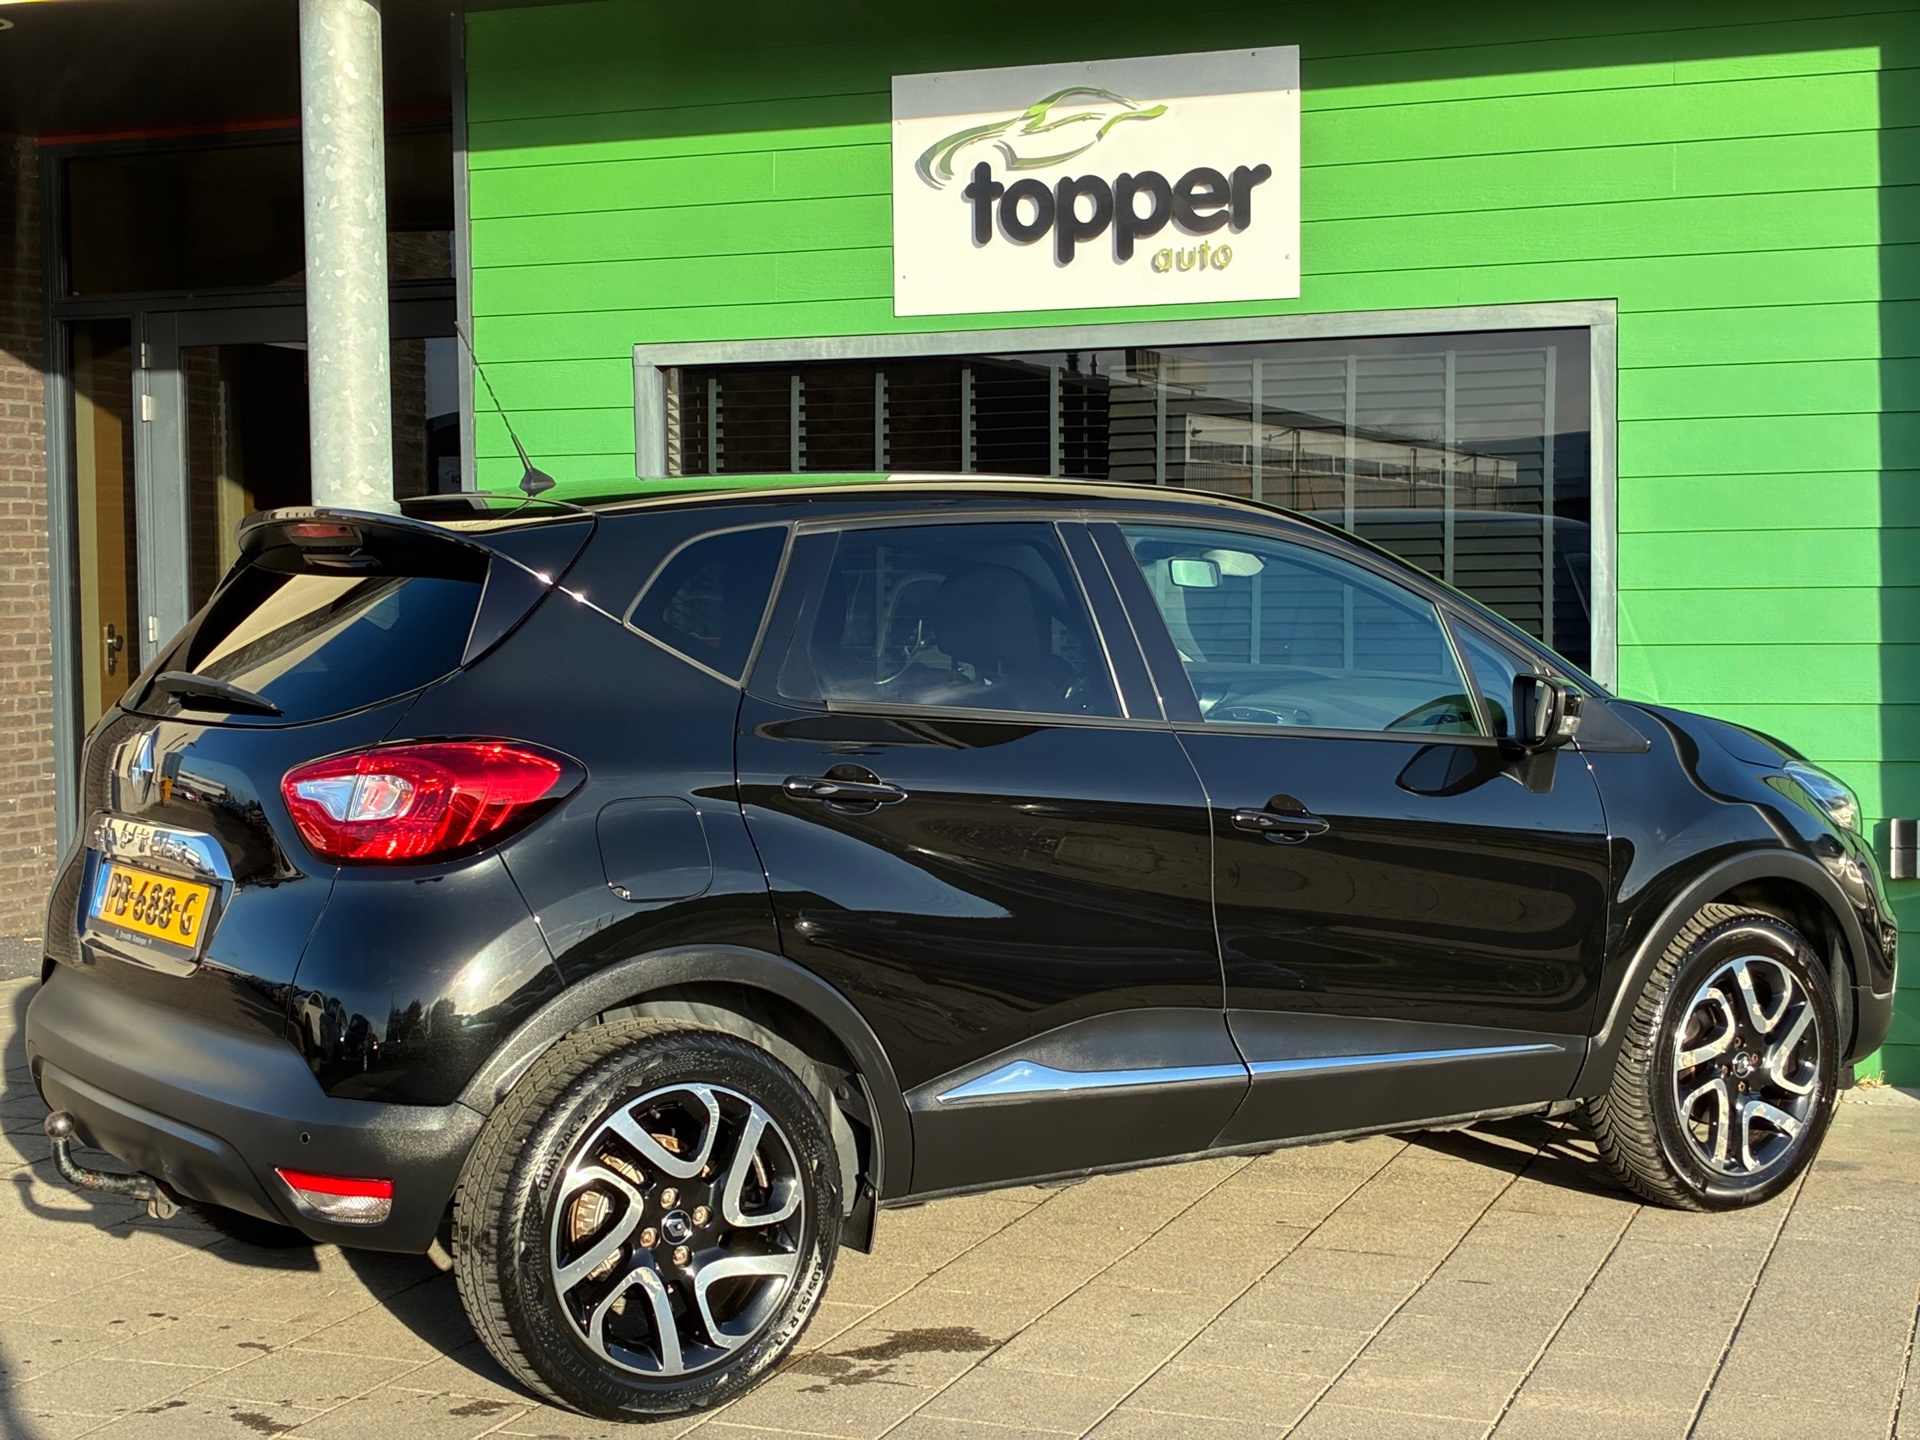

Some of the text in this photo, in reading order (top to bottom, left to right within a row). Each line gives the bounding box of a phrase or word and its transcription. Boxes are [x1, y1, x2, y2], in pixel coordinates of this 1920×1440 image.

[963, 160, 1273, 264] topper
[1153, 240, 1233, 272] auto
[104, 872, 200, 936] PB-688-G
[538, 1114, 588, 1191] QUATRAC 5
